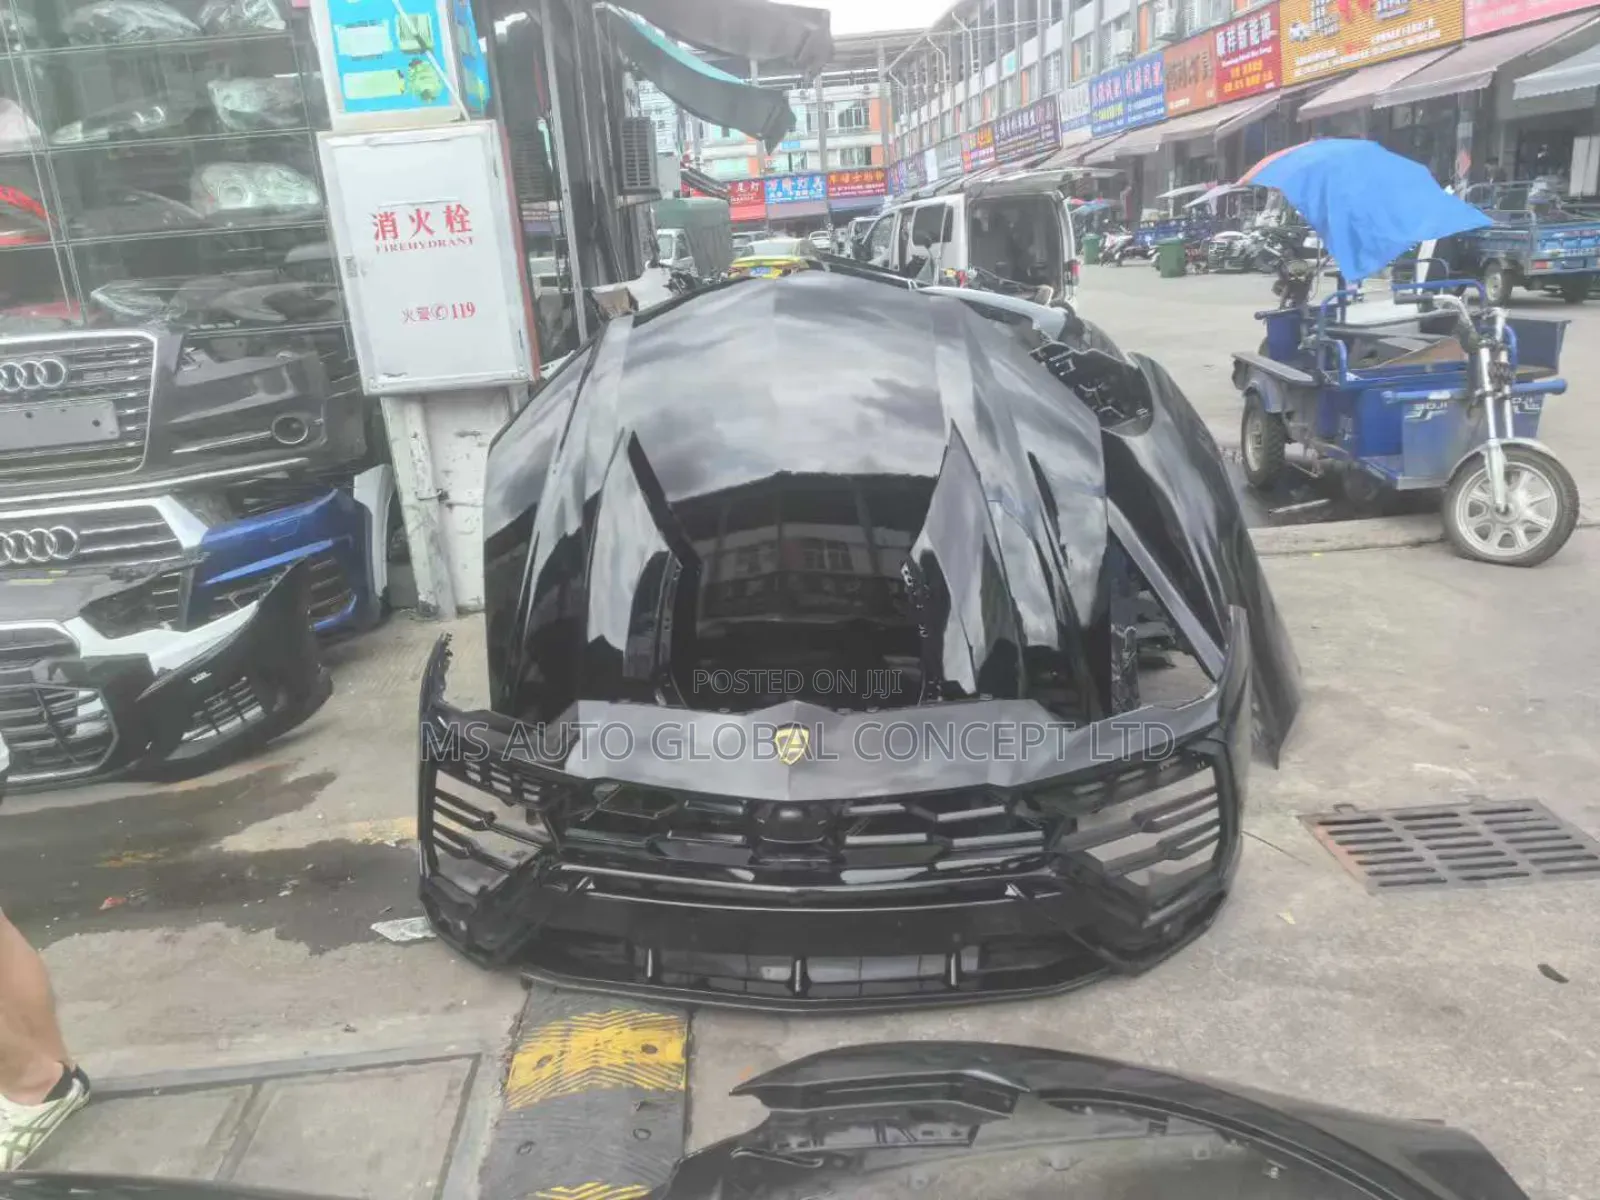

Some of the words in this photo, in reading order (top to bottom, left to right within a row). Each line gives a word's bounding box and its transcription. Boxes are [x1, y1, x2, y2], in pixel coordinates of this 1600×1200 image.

[372, 203, 473, 241] 消火栓
[376, 237, 474, 253] FIREHYDRANT
[452, 301, 476, 319] 119
